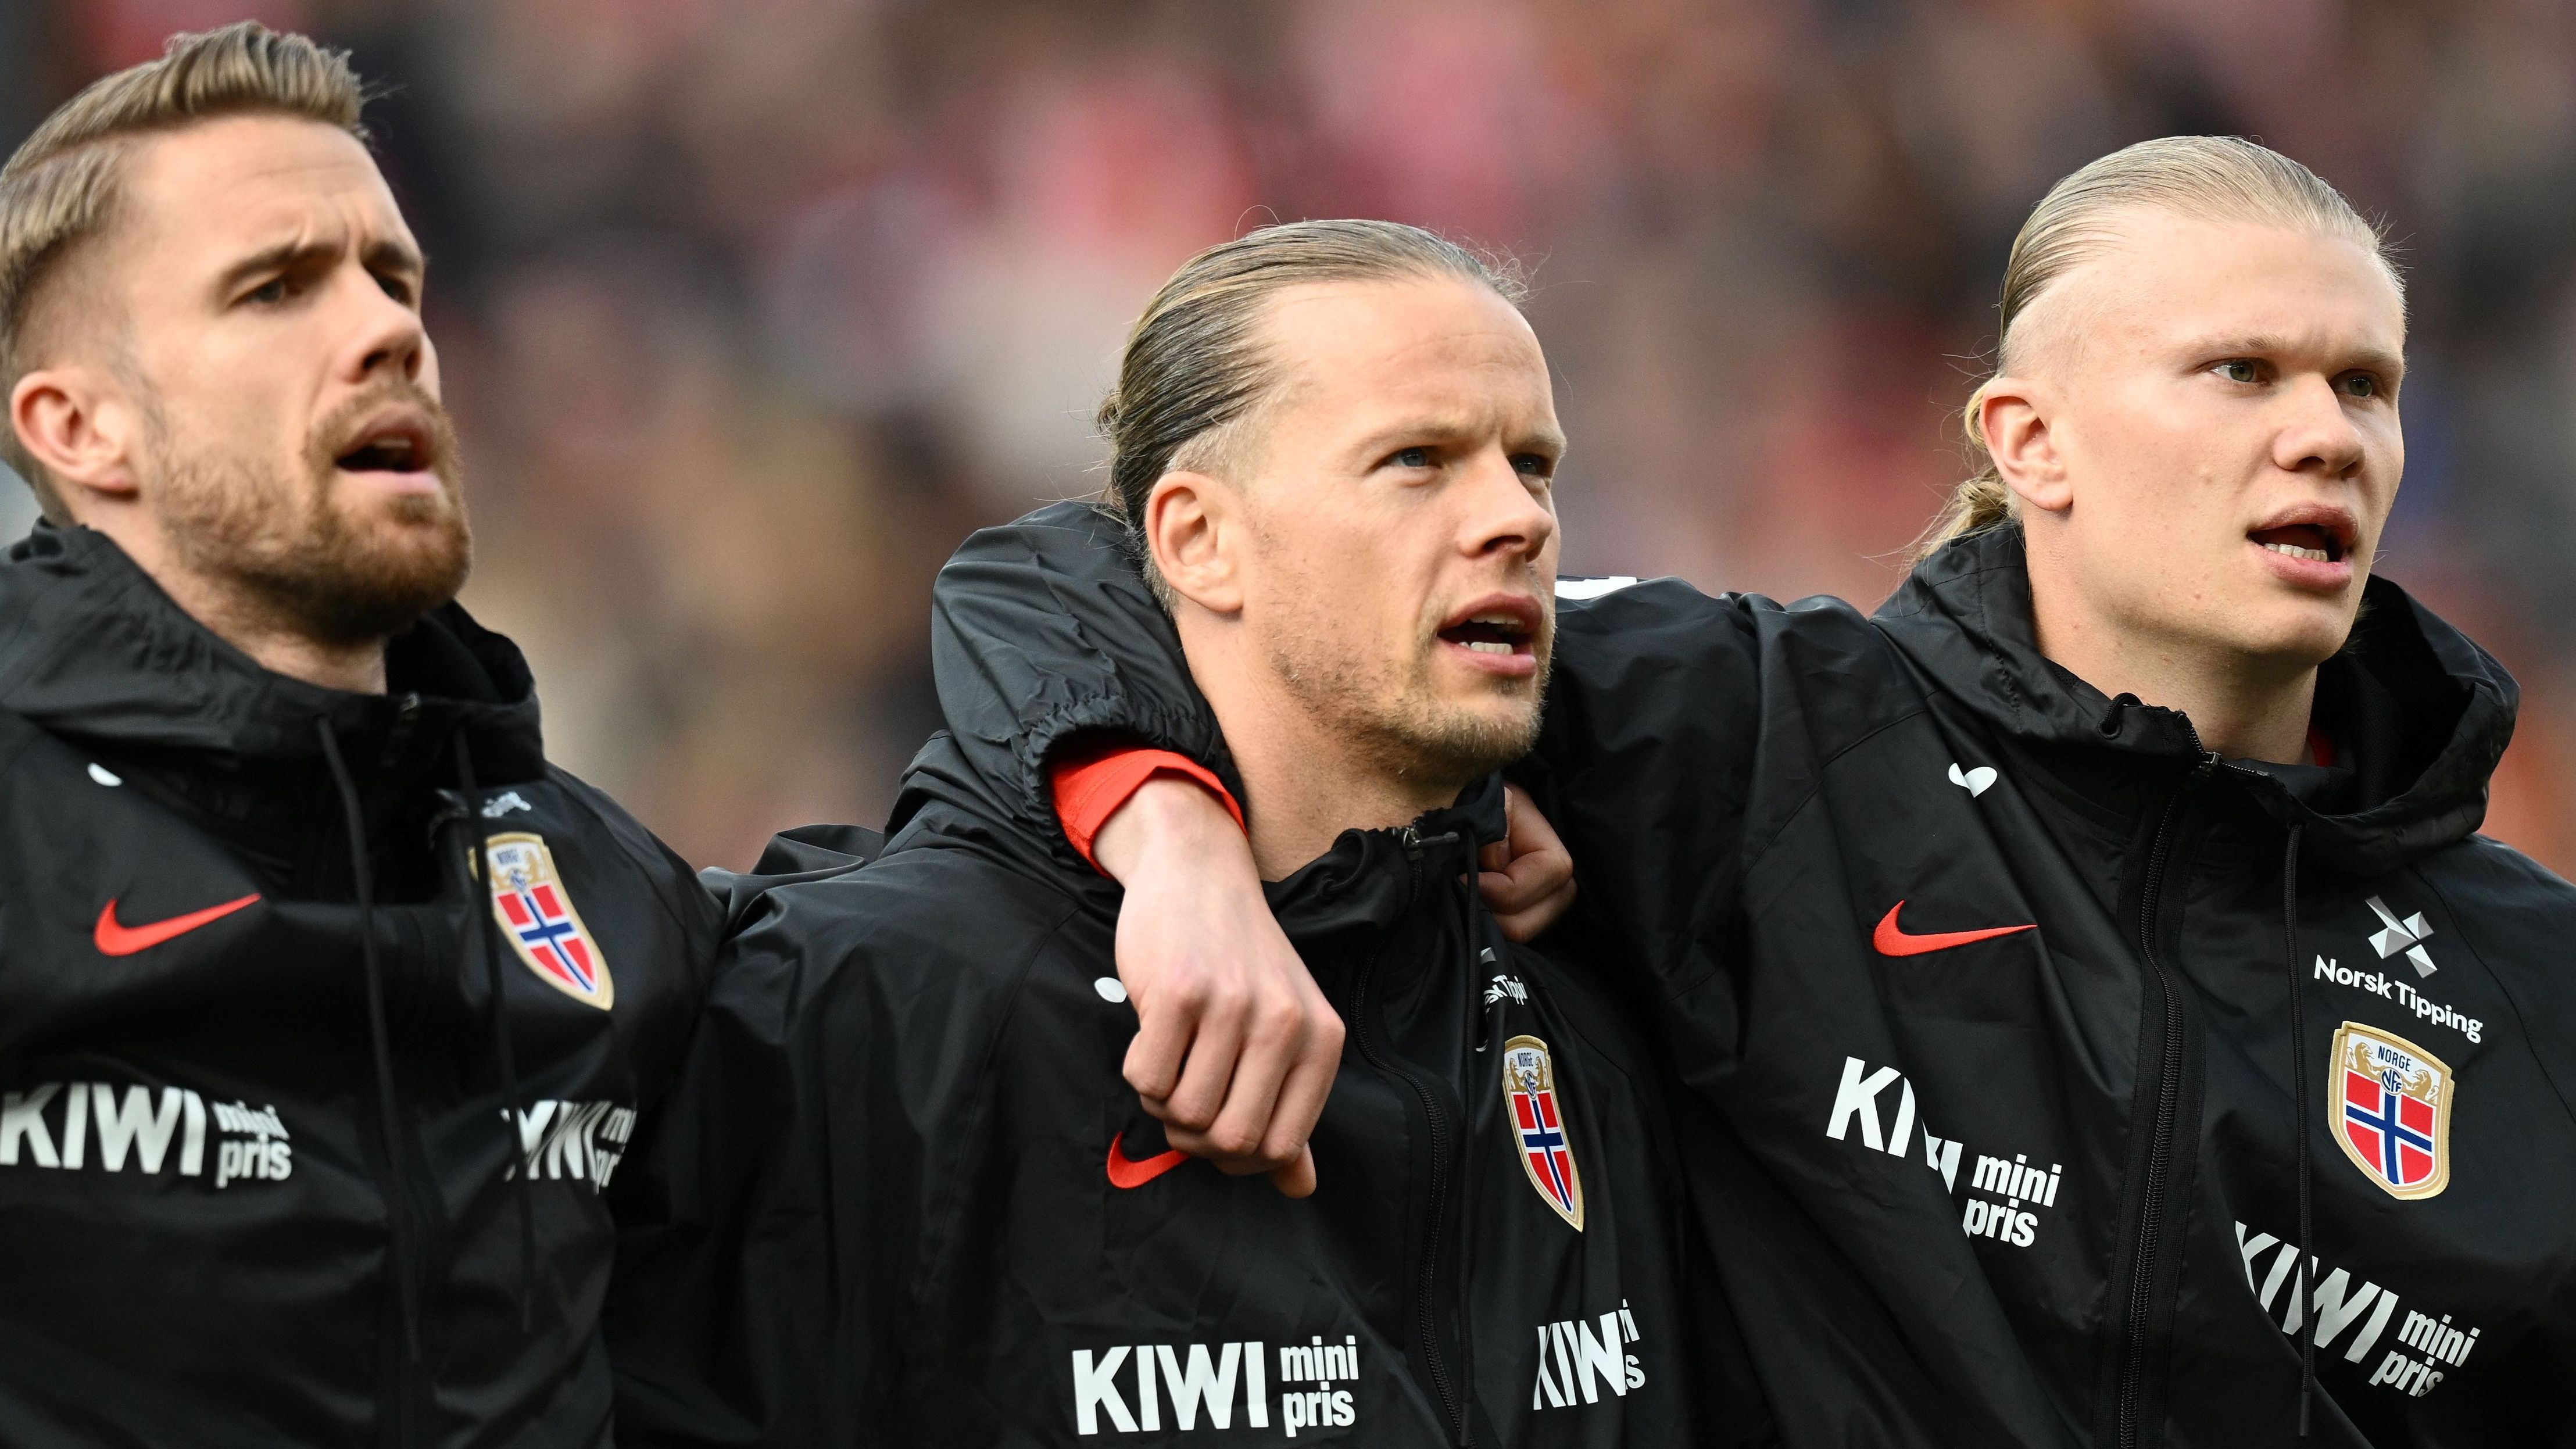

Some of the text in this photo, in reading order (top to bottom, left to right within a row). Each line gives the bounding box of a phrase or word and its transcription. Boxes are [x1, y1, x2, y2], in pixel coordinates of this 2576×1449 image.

[1492, 974, 1528, 1006] Tippin
[2314, 954, 2483, 1044] Norsk Tipping
[1517, 1053, 1534, 1067] NORGE
[2378, 1046, 2412, 1072] NORGE
[0, 1083, 206, 1176] KIWI
[215, 1133, 292, 1189] pris
[1972, 1153, 2062, 1207] mini
[1962, 1198, 2038, 1247] pris
[2235, 1221, 2481, 1367] KIWI mini
[1072, 1335, 1359, 1435] KIWI mini
[1533, 1311, 1626, 1410] KIW
[2369, 1350, 2443, 1397] pris
[1283, 1381, 1356, 1437] pris
